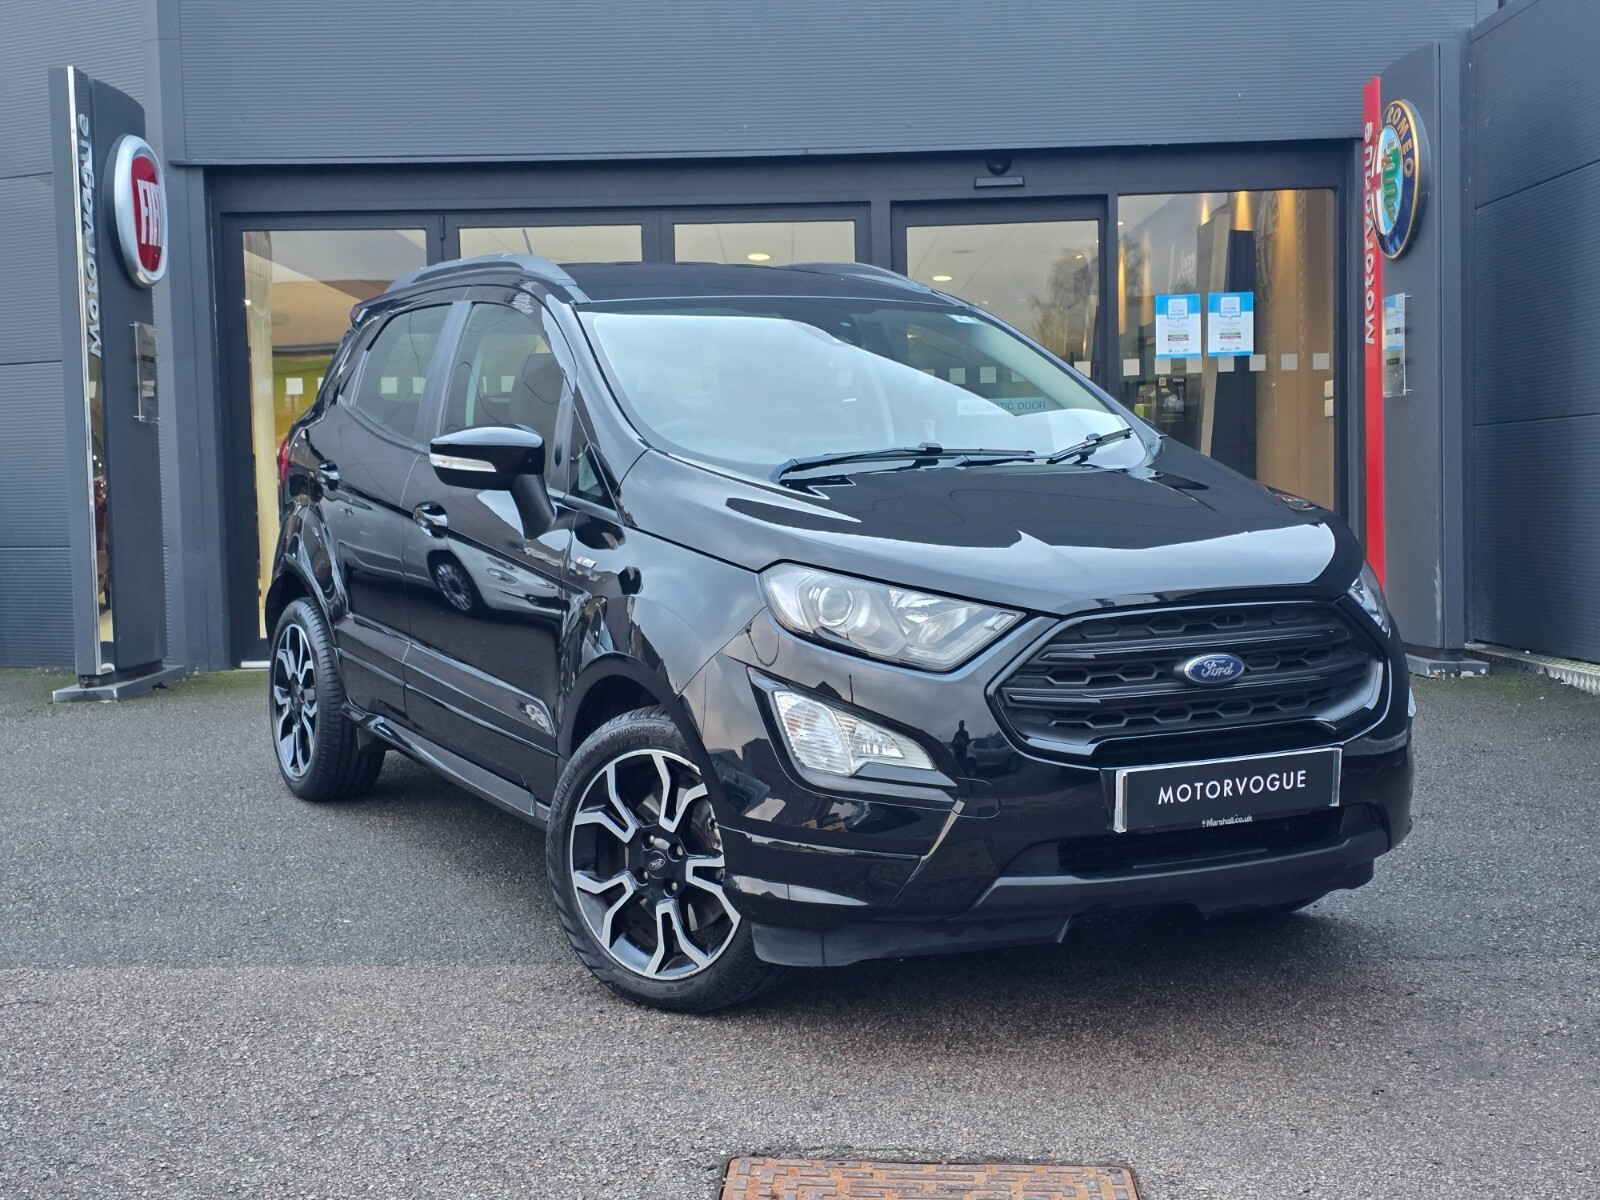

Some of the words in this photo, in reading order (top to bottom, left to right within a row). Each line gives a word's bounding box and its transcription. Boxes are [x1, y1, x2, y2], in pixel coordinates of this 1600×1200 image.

[1386, 106, 1414, 178] ROMEO
[78, 113, 101, 357] Motorvogue
[1364, 121, 1375, 345] Motorvogue
[1017, 401, 1046, 411] DOOR
[1201, 659, 1234, 678] Ford
[609, 724, 657, 739] RainSport
[1158, 770, 1306, 805] MOTORVOGUE
[1206, 815, 1252, 827] Marshall.co.uk
